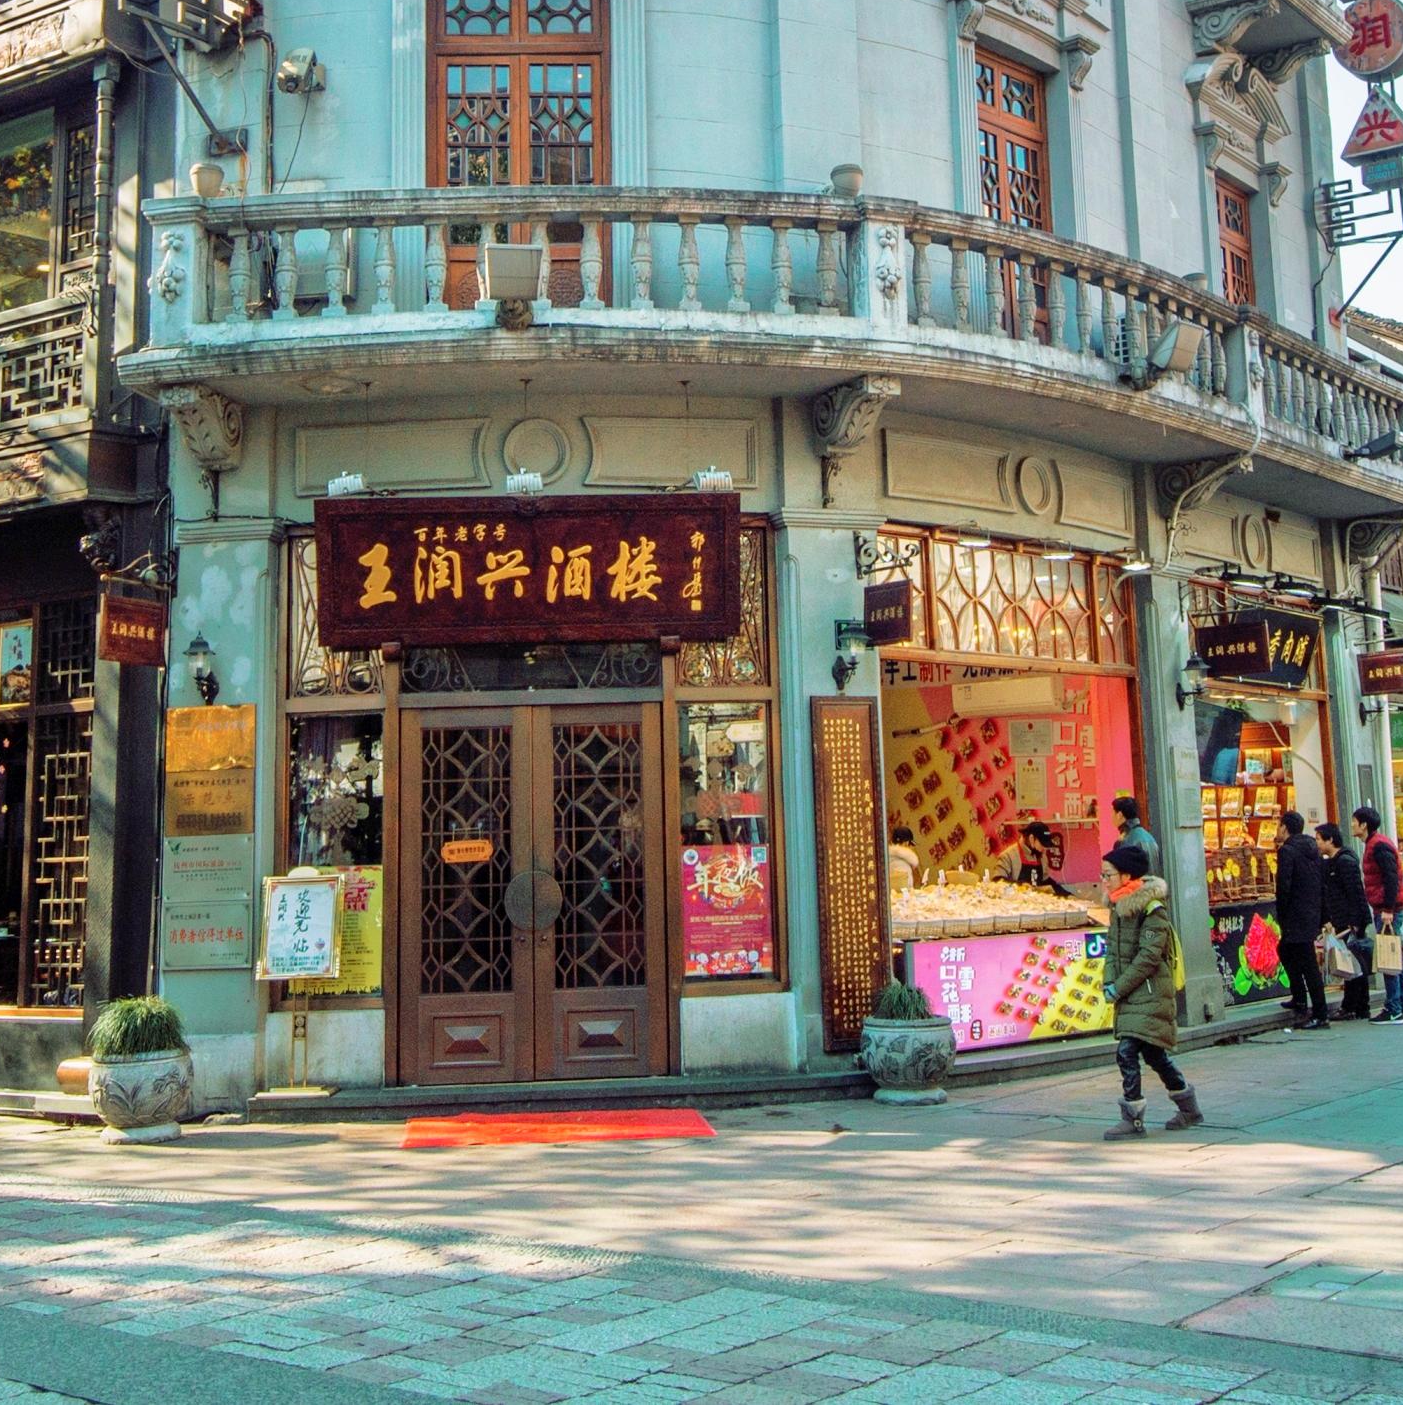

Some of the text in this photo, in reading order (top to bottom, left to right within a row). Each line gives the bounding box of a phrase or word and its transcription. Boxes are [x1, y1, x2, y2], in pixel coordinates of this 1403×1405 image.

[413, 523, 508, 544] 百年老字号
[358, 536, 663, 610] 王润兴酒楼
[293, 888, 312, 953] 欢迎光临
